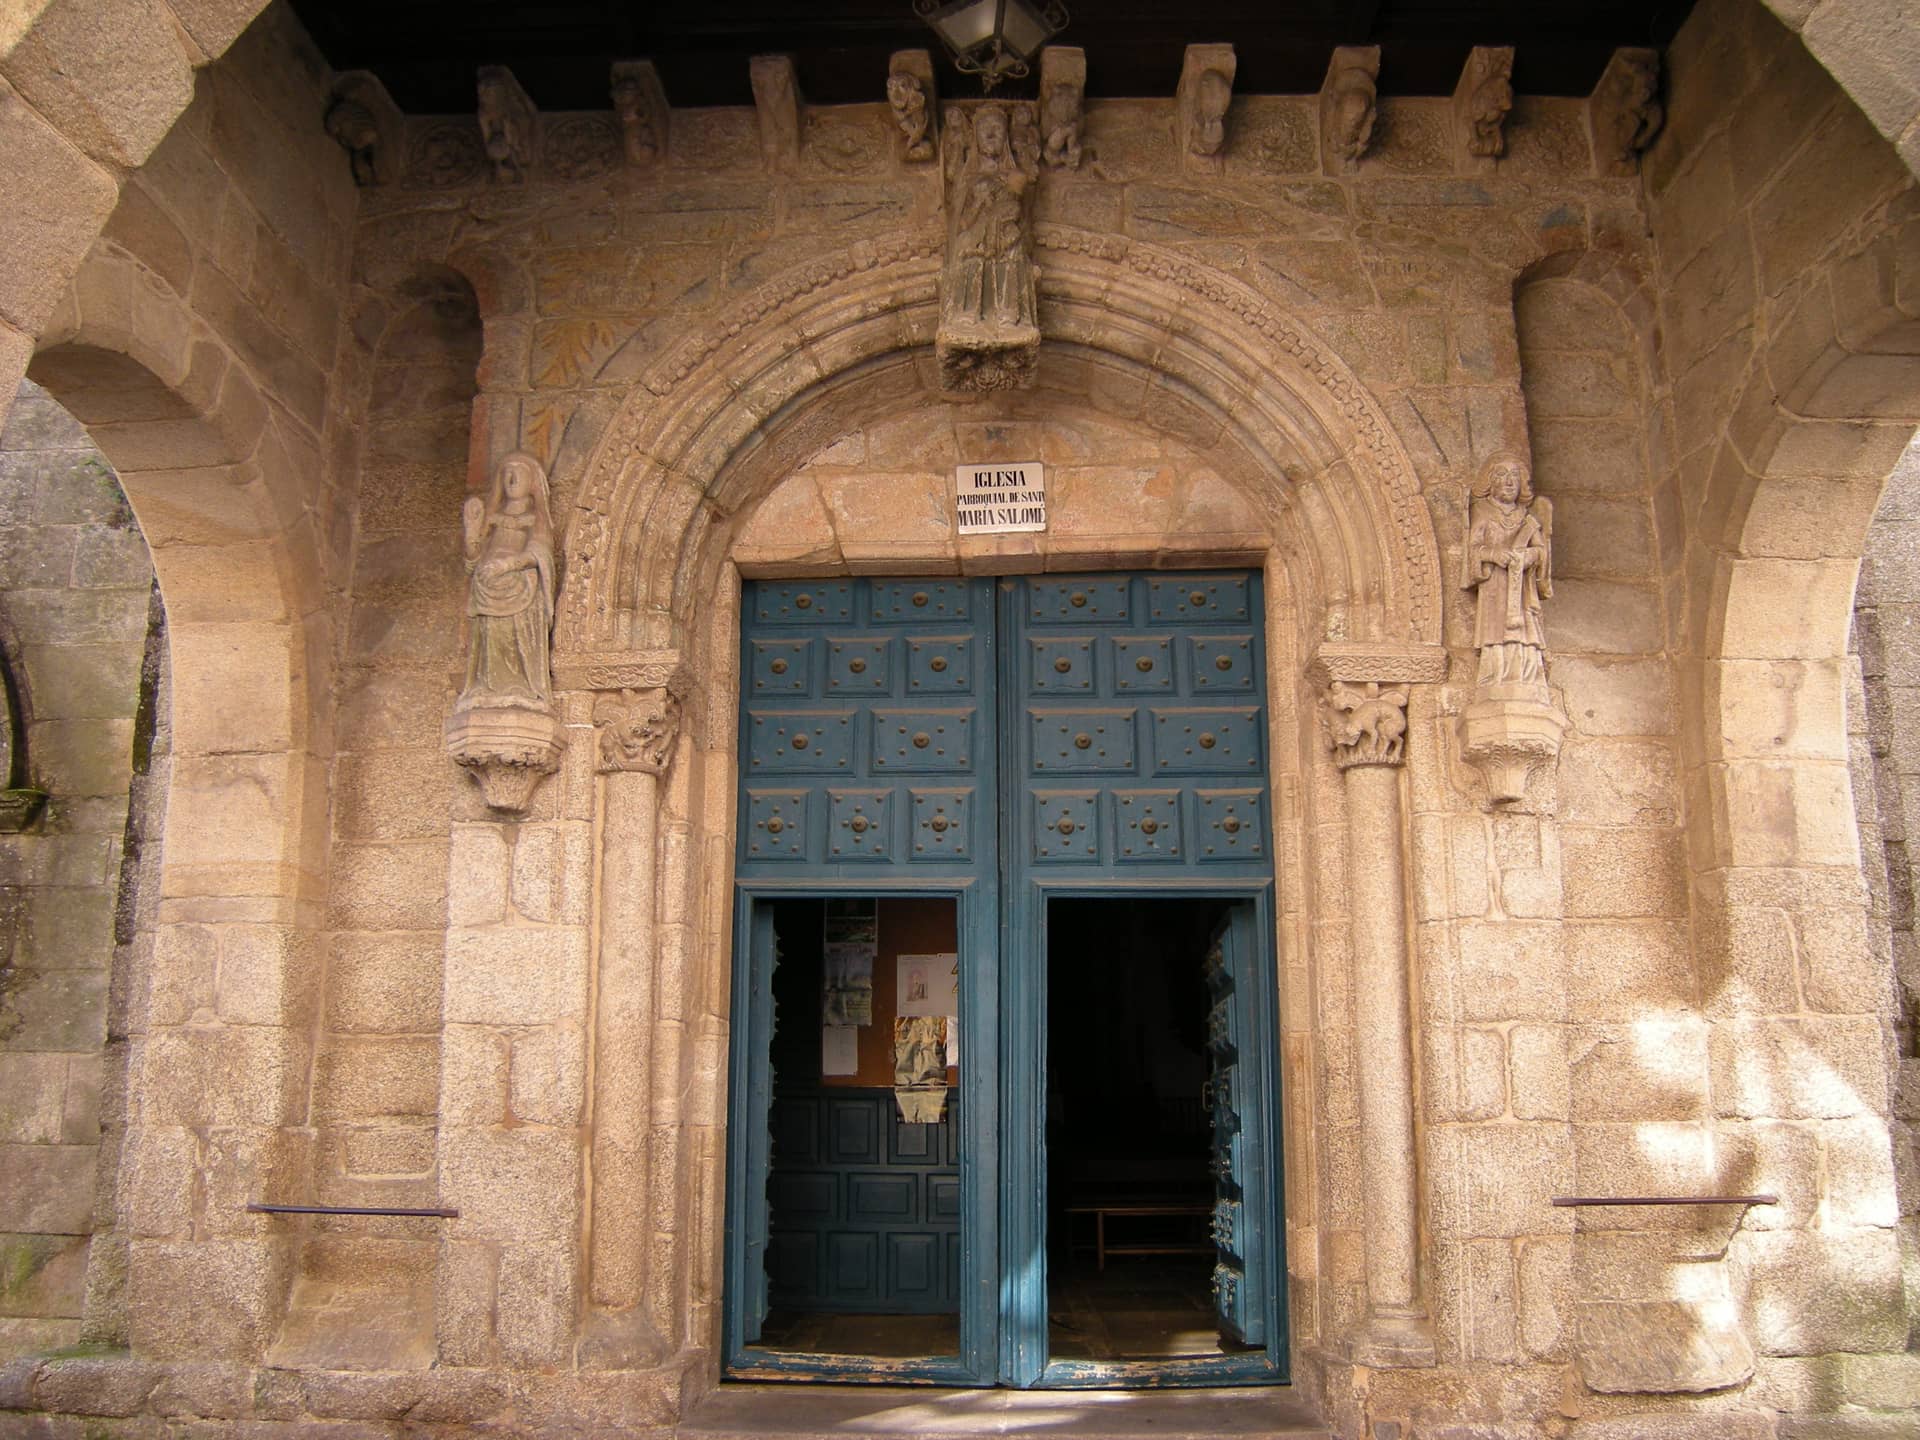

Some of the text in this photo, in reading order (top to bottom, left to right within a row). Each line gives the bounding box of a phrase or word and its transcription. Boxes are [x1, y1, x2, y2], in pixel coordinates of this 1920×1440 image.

[975, 470, 1026, 488] IGLESIA
[956, 492, 1008, 506] PARROQUIAL
[1009, 492, 1020, 503] DE
[998, 503, 1046, 524] SALOMÉ
